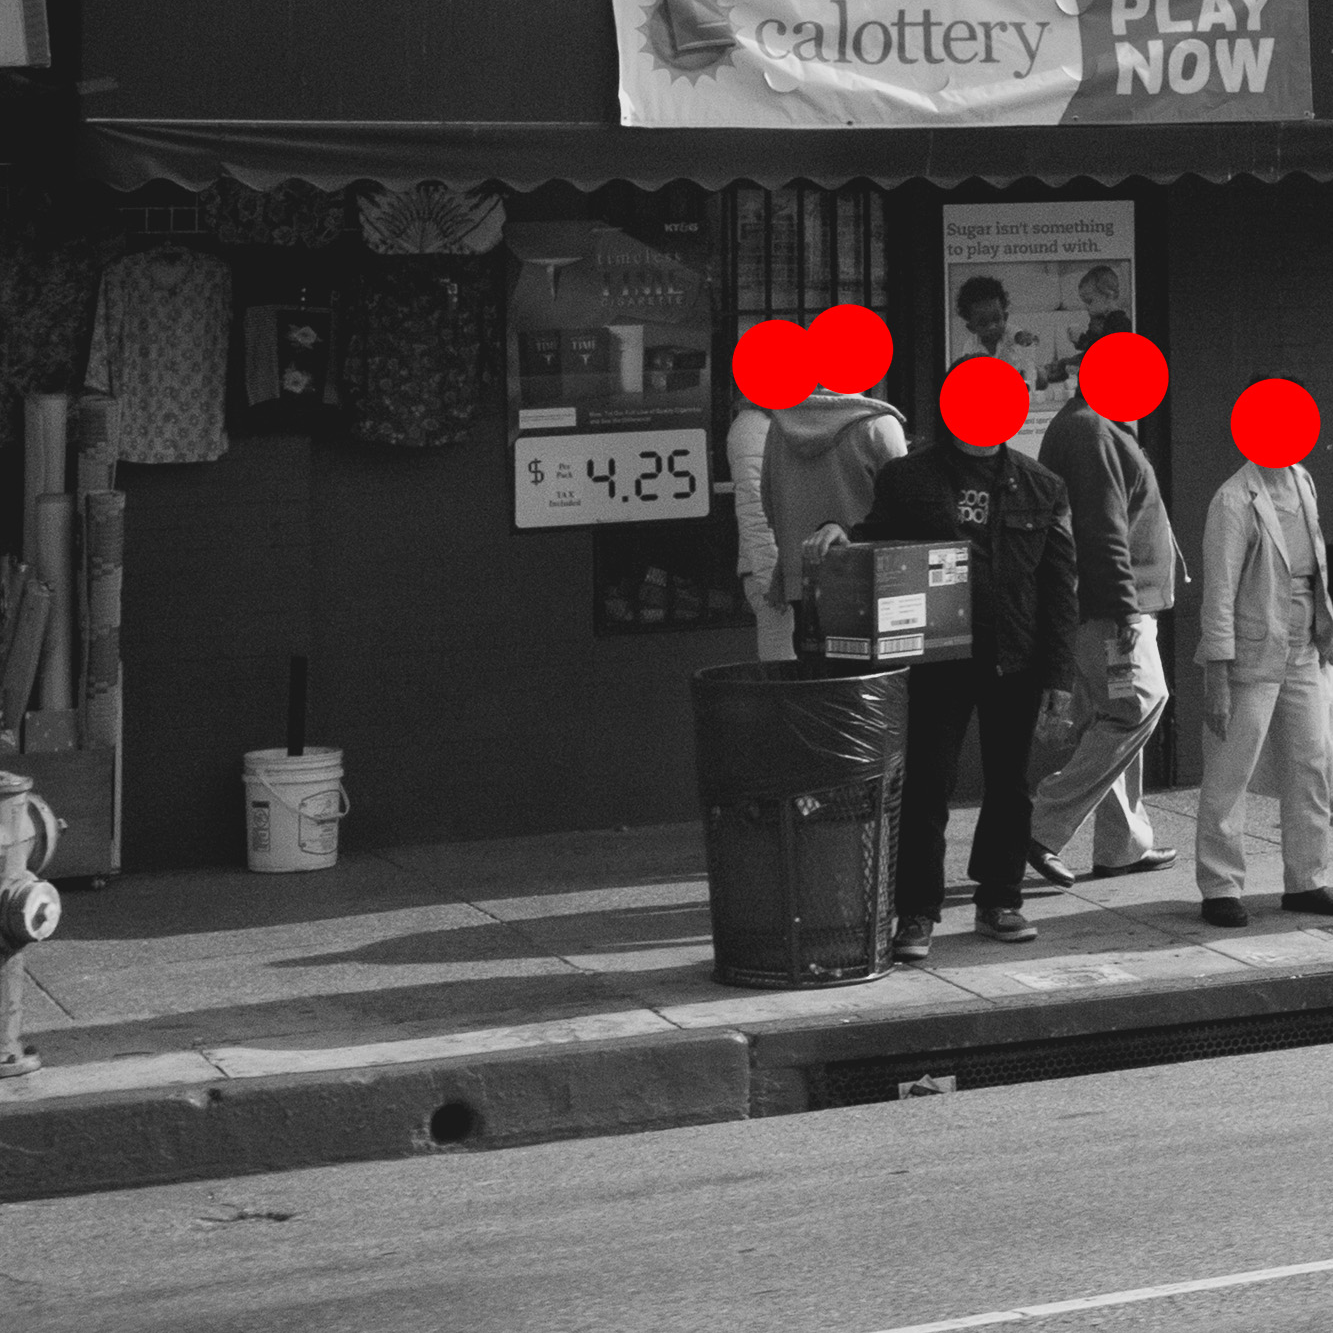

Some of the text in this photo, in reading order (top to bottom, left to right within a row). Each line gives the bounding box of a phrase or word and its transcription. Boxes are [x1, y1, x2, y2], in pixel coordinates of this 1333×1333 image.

[1114, 38, 1276, 96] NOW
[664, 222, 699, 233] KT&G
[947, 220, 1115, 239] Sugar isn't something
[947, 238, 1102, 259] to play around with.
[528, 449, 697, 503] $ 4.25
[556, 490, 575, 499] TAX
